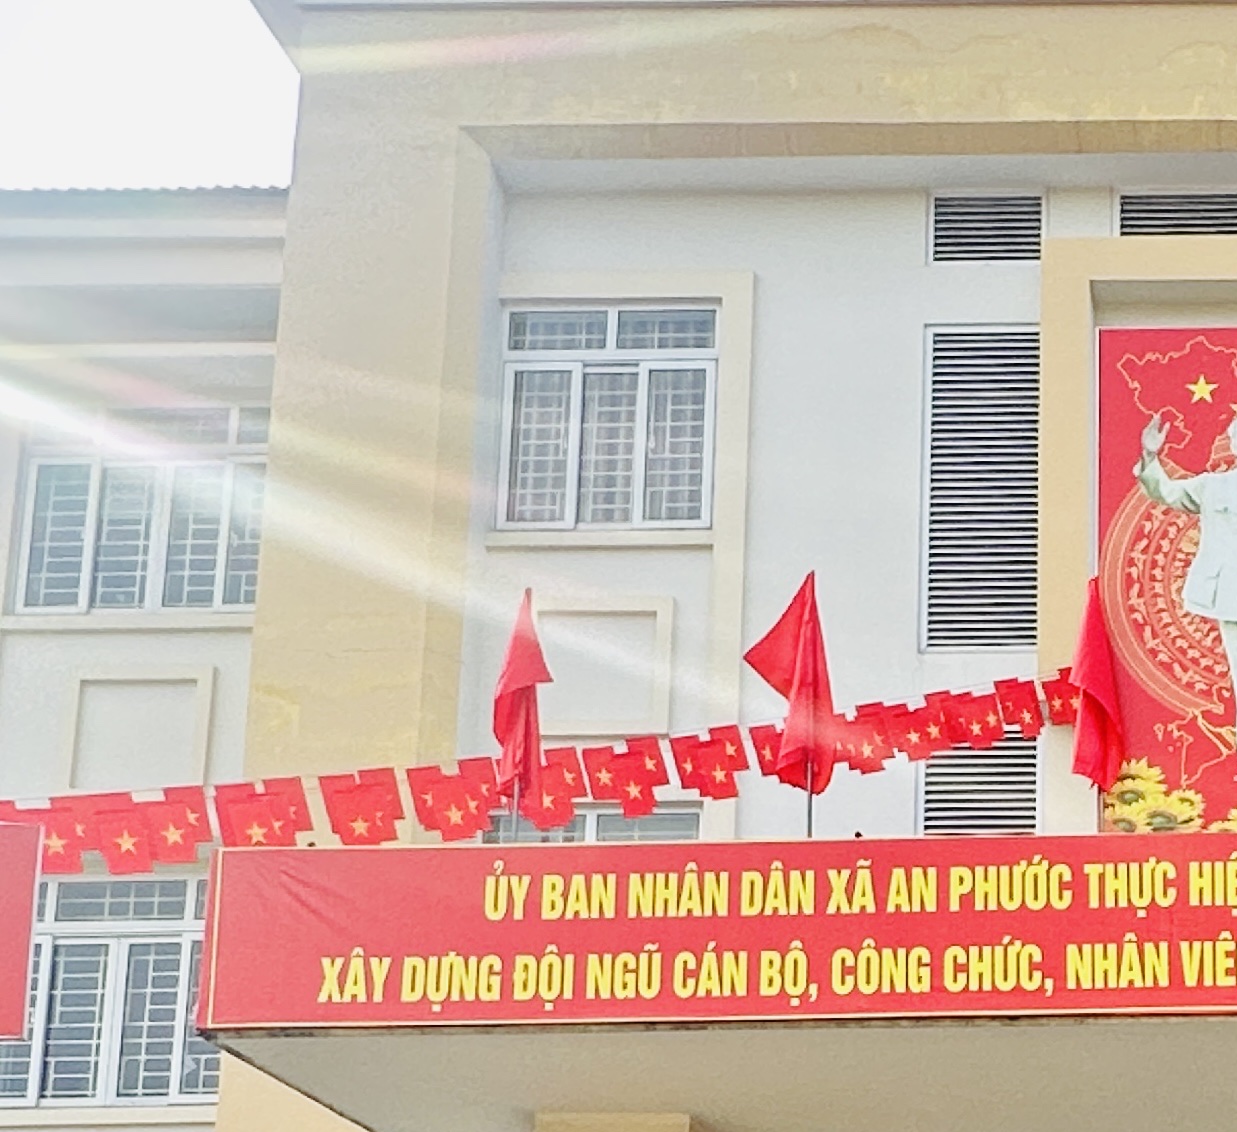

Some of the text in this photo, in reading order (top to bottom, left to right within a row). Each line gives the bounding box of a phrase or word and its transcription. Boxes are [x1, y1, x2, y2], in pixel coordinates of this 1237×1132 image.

[484, 860, 531, 921] ỦY
[541, 873, 616, 920] BAN
[628, 862, 728, 918] NHÂN
[741, 861, 814, 916] DÂN
[826, 859, 875, 914] XÃ
[887, 867, 937, 913] AN
[950, 855, 1072, 912] PHƯỚC
[1084, 857, 1177, 917] THỰC
[317, 947, 392, 1003] XÂY
[400, 951, 502, 1012] DỰNG
[512, 944, 574, 1011] ĐỘI
[586, 943, 661, 999] NGŨ
[673, 941, 747, 998] CÁN
[760, 940, 818, 1006] BỘ,
[832, 938, 930, 995] CÔNG
[944, 936, 1053, 996] CHỨC,
[1066, 933, 1169, 989] NHÂN
